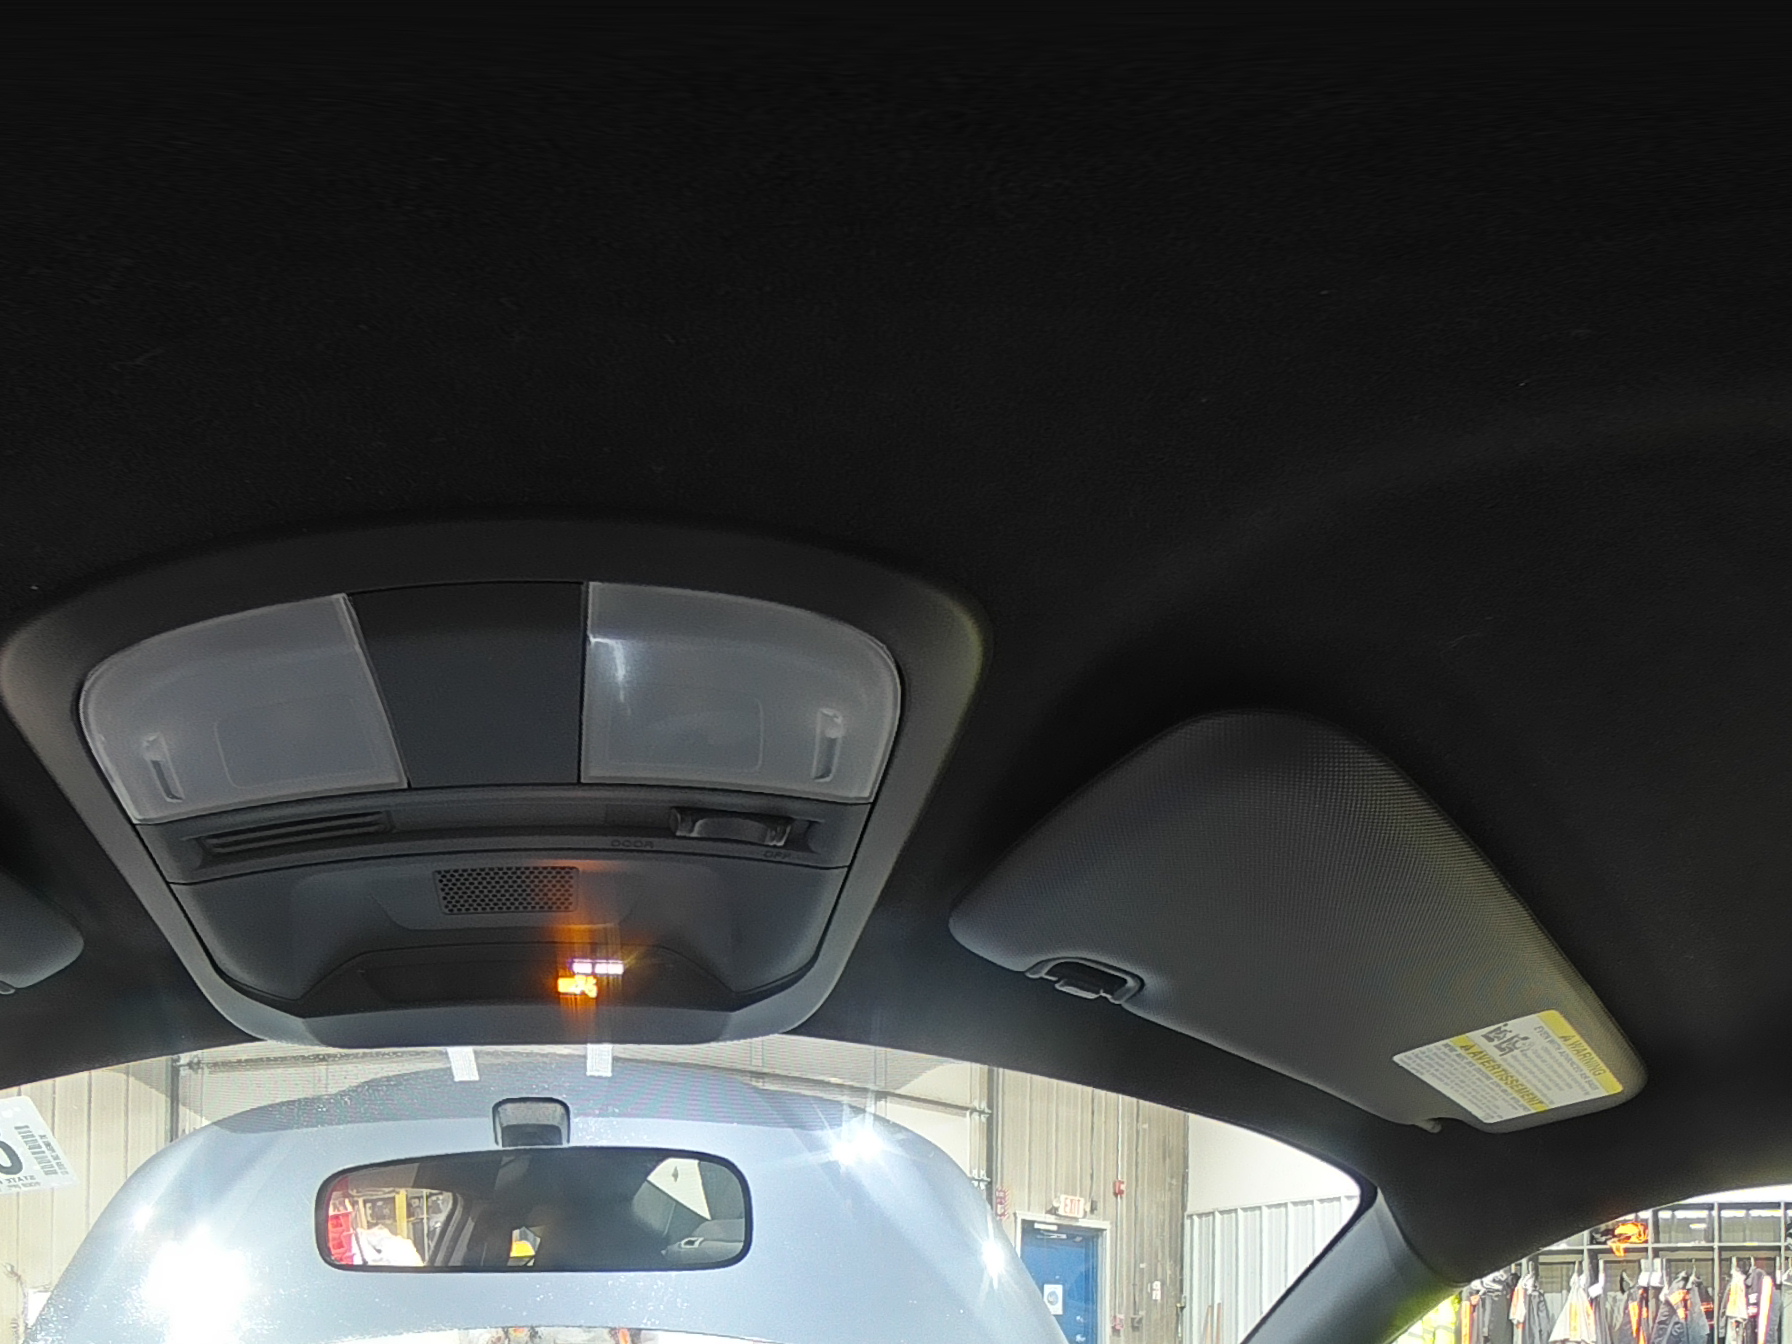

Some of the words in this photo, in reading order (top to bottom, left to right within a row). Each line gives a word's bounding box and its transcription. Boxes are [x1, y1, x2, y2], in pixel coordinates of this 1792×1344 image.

[610, 838, 655, 849] DOOR
[1564, 1040, 1607, 1077] WARNING
[1468, 1047, 1543, 1107] AVERTISSEMENT
[1064, 1196, 1081, 1216] EXIT
